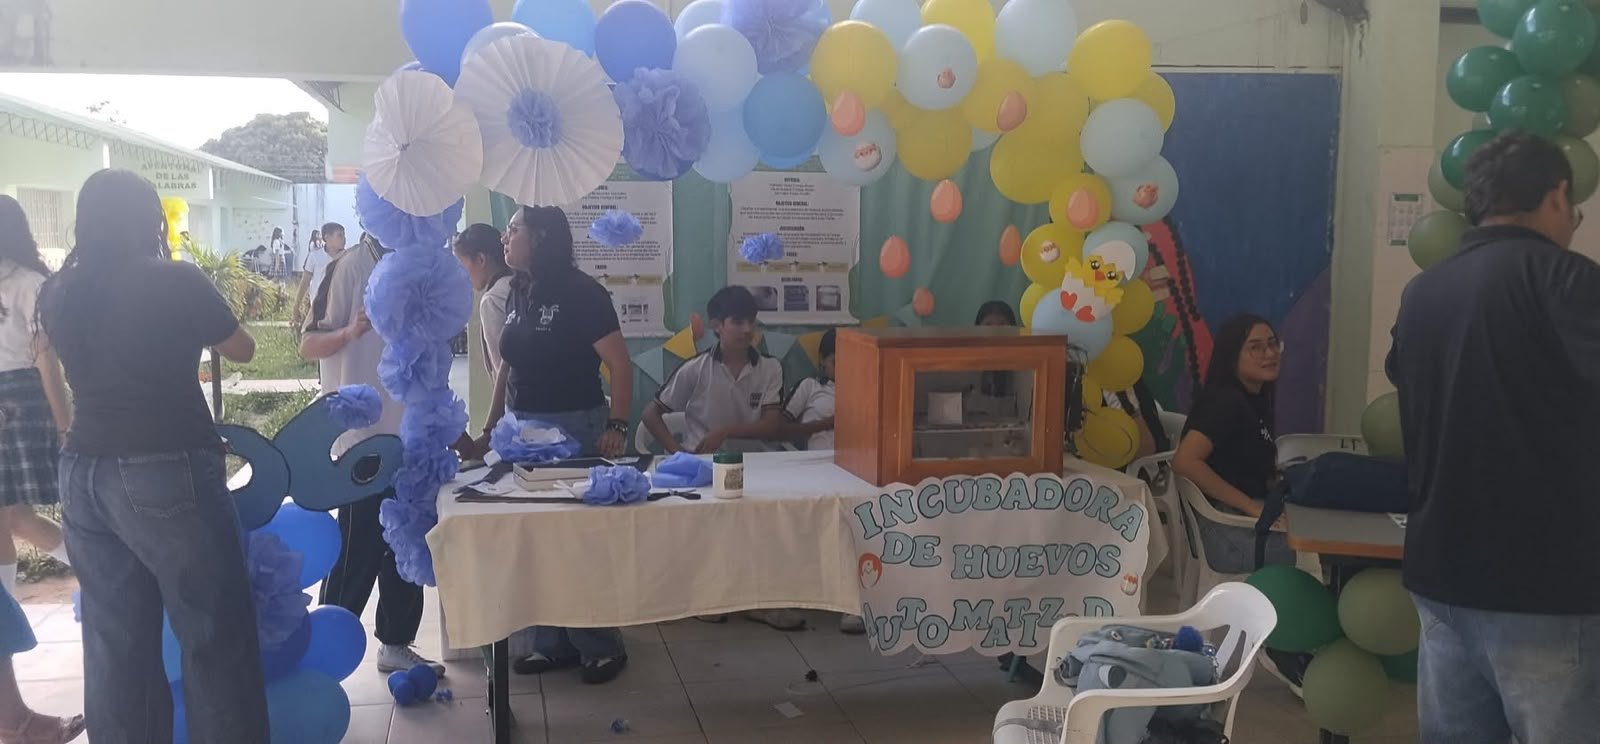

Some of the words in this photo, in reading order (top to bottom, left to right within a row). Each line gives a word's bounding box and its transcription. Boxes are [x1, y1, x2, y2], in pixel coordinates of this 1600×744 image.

[854, 478, 1144, 542] INCUBADORA
[880, 531, 942, 567] DE
[951, 542, 1121, 578] HUEVOS
[864, 597, 1114, 650] AUTOMATIZD
